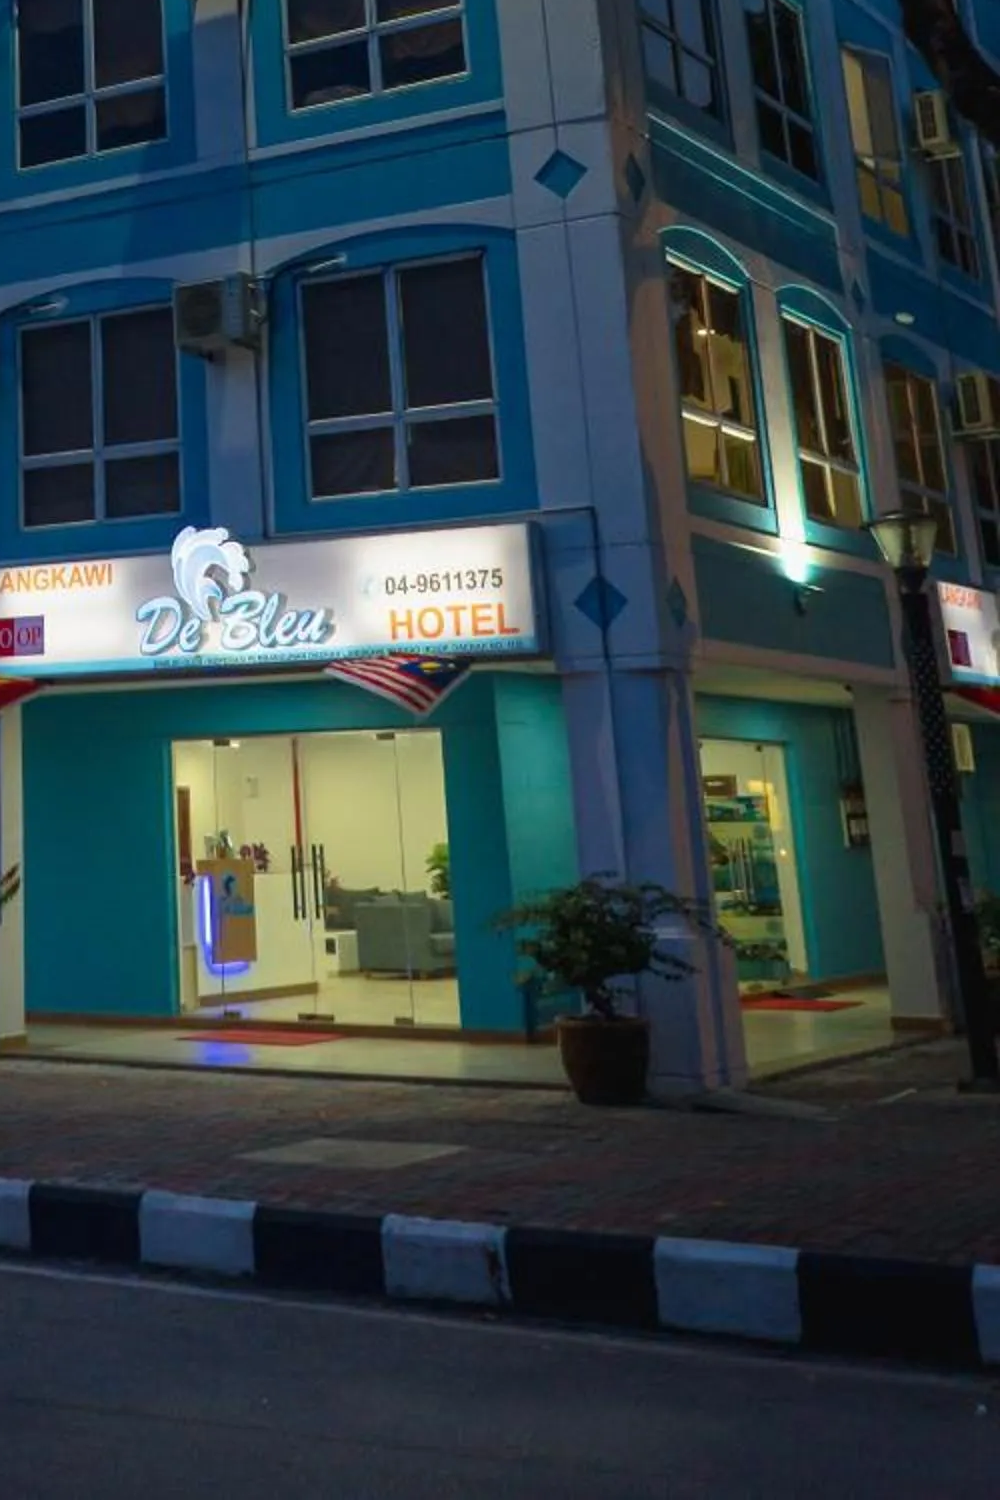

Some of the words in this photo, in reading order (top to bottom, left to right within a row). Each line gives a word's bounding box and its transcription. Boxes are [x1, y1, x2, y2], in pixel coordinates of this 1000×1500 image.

[385, 568, 503, 596] 04-9611375
[136, 597, 201, 656] De
[219, 590, 331, 650] Bleu
[390, 603, 521, 641] HOTEL
